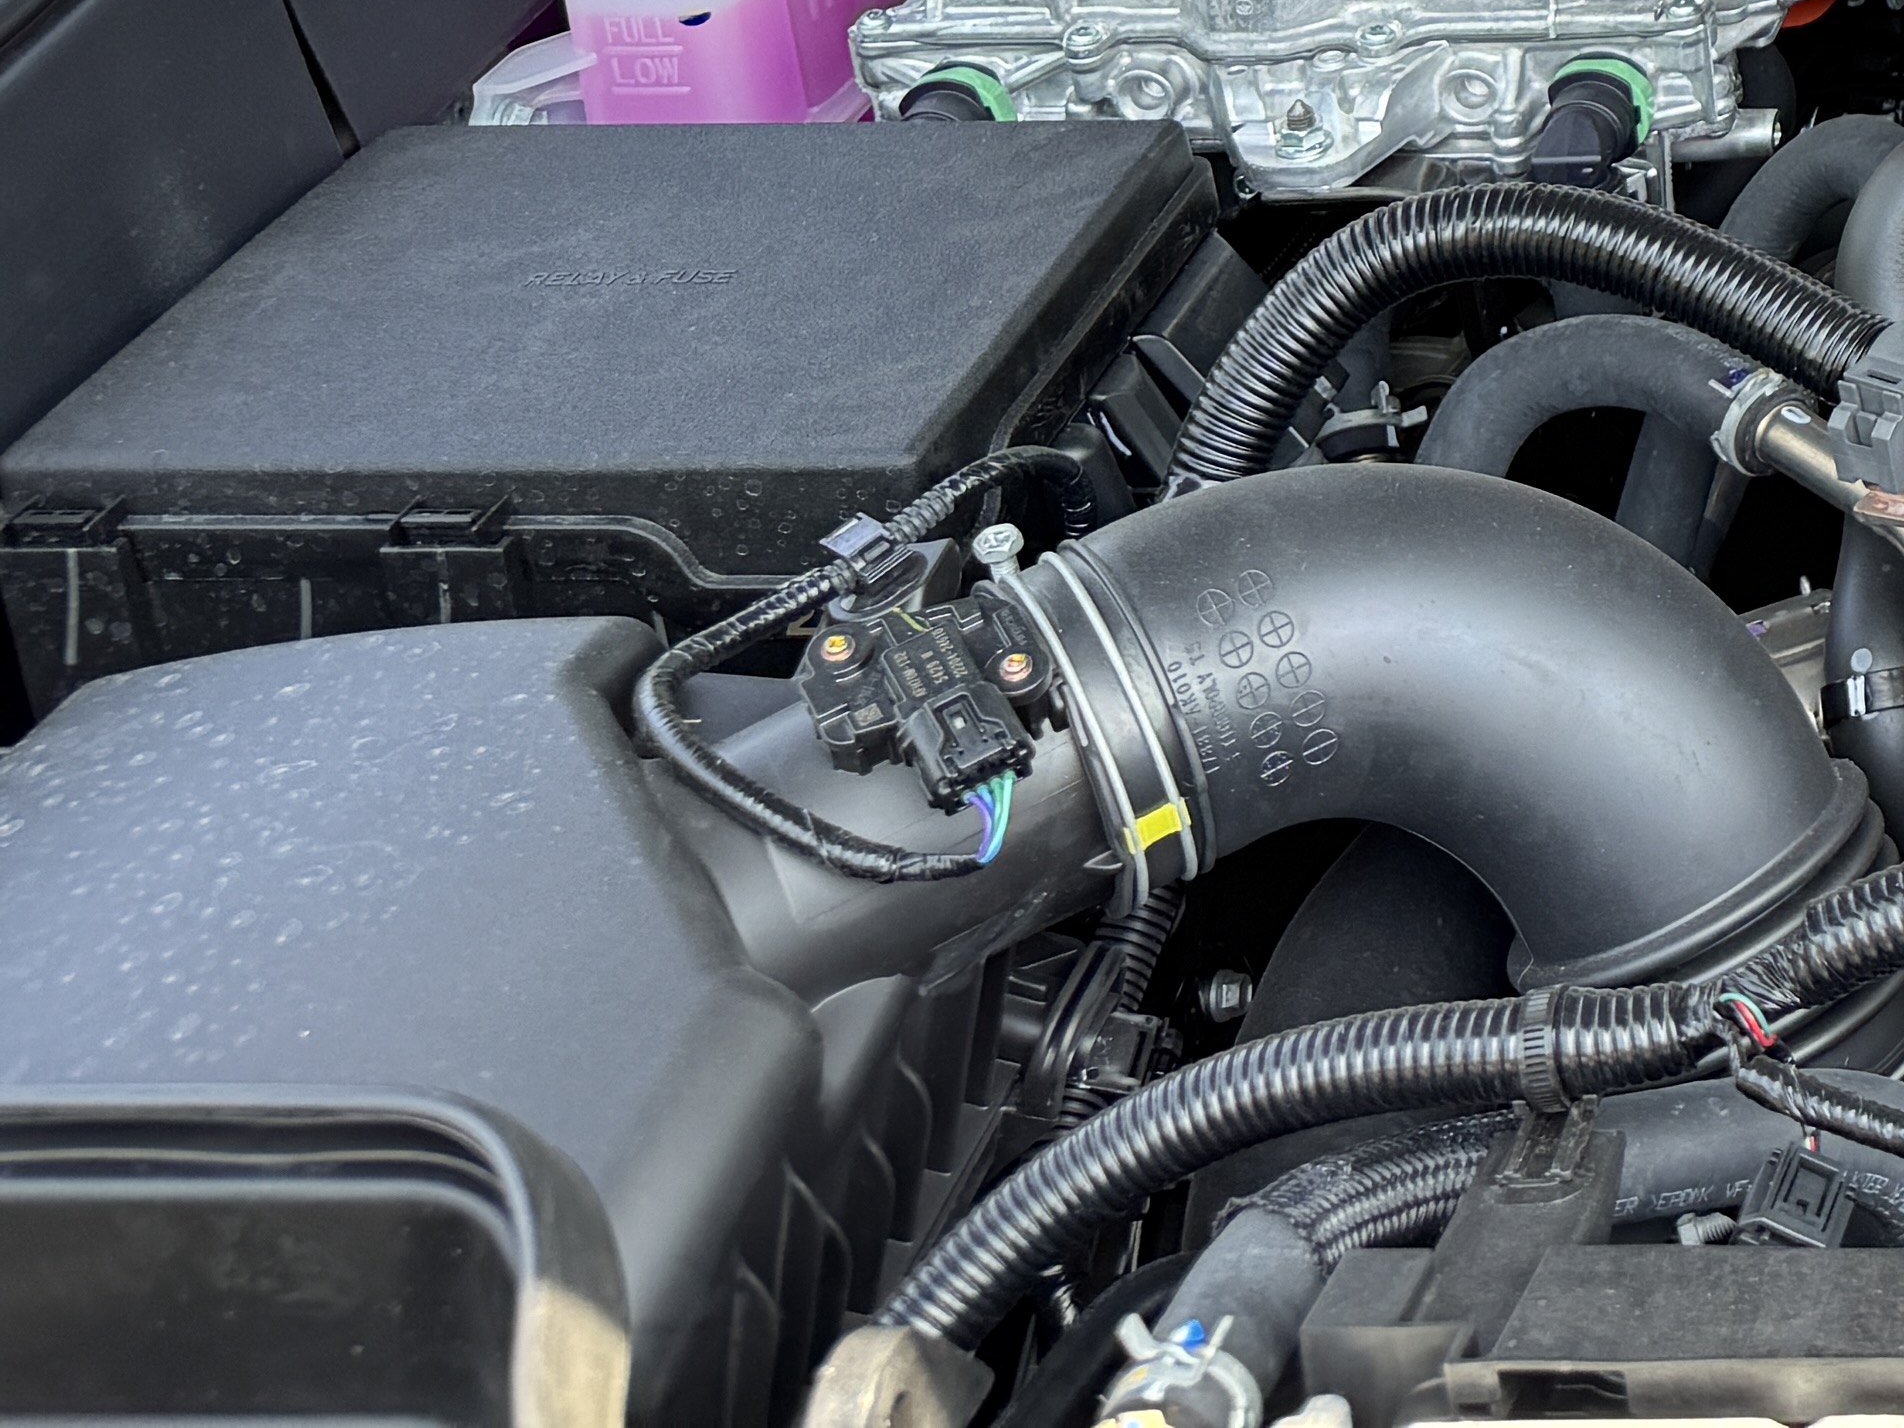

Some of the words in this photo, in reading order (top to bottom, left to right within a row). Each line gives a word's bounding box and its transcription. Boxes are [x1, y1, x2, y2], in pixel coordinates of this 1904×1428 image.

[603, 16, 674, 43] FULL
[610, 56, 678, 84] LOW
[524, 270, 629, 287] RELAY
[626, 271, 646, 286] &
[653, 269, 738, 285] FUSE
